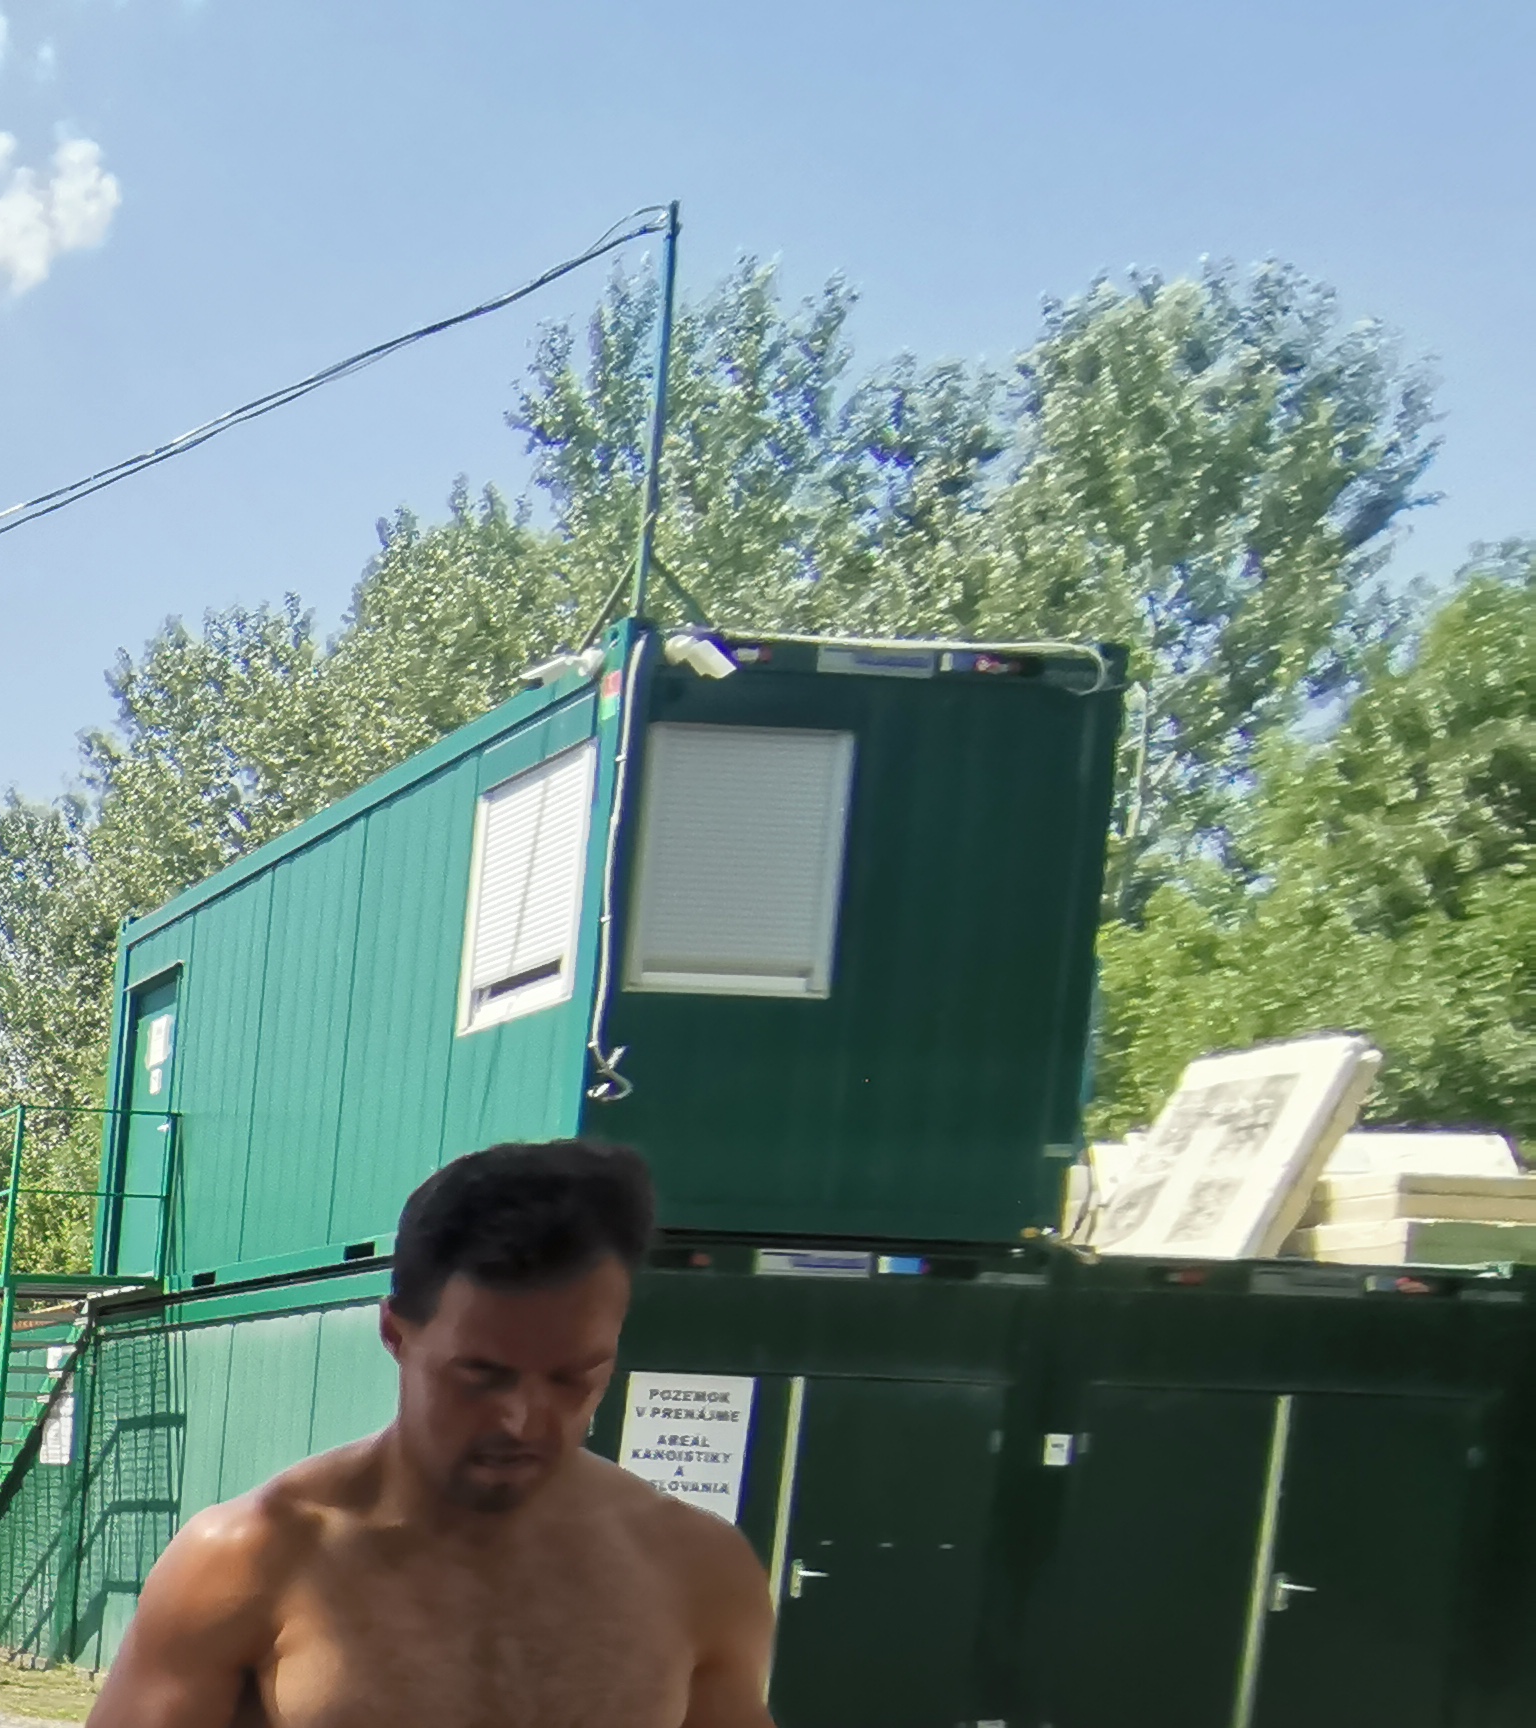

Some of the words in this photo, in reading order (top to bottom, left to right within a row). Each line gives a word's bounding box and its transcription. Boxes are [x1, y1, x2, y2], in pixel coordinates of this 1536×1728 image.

[649, 1388, 730, 1403] POZEMOK
[636, 1407, 646, 1417] V
[630, 1449, 733, 1464] KANOISTIKY
